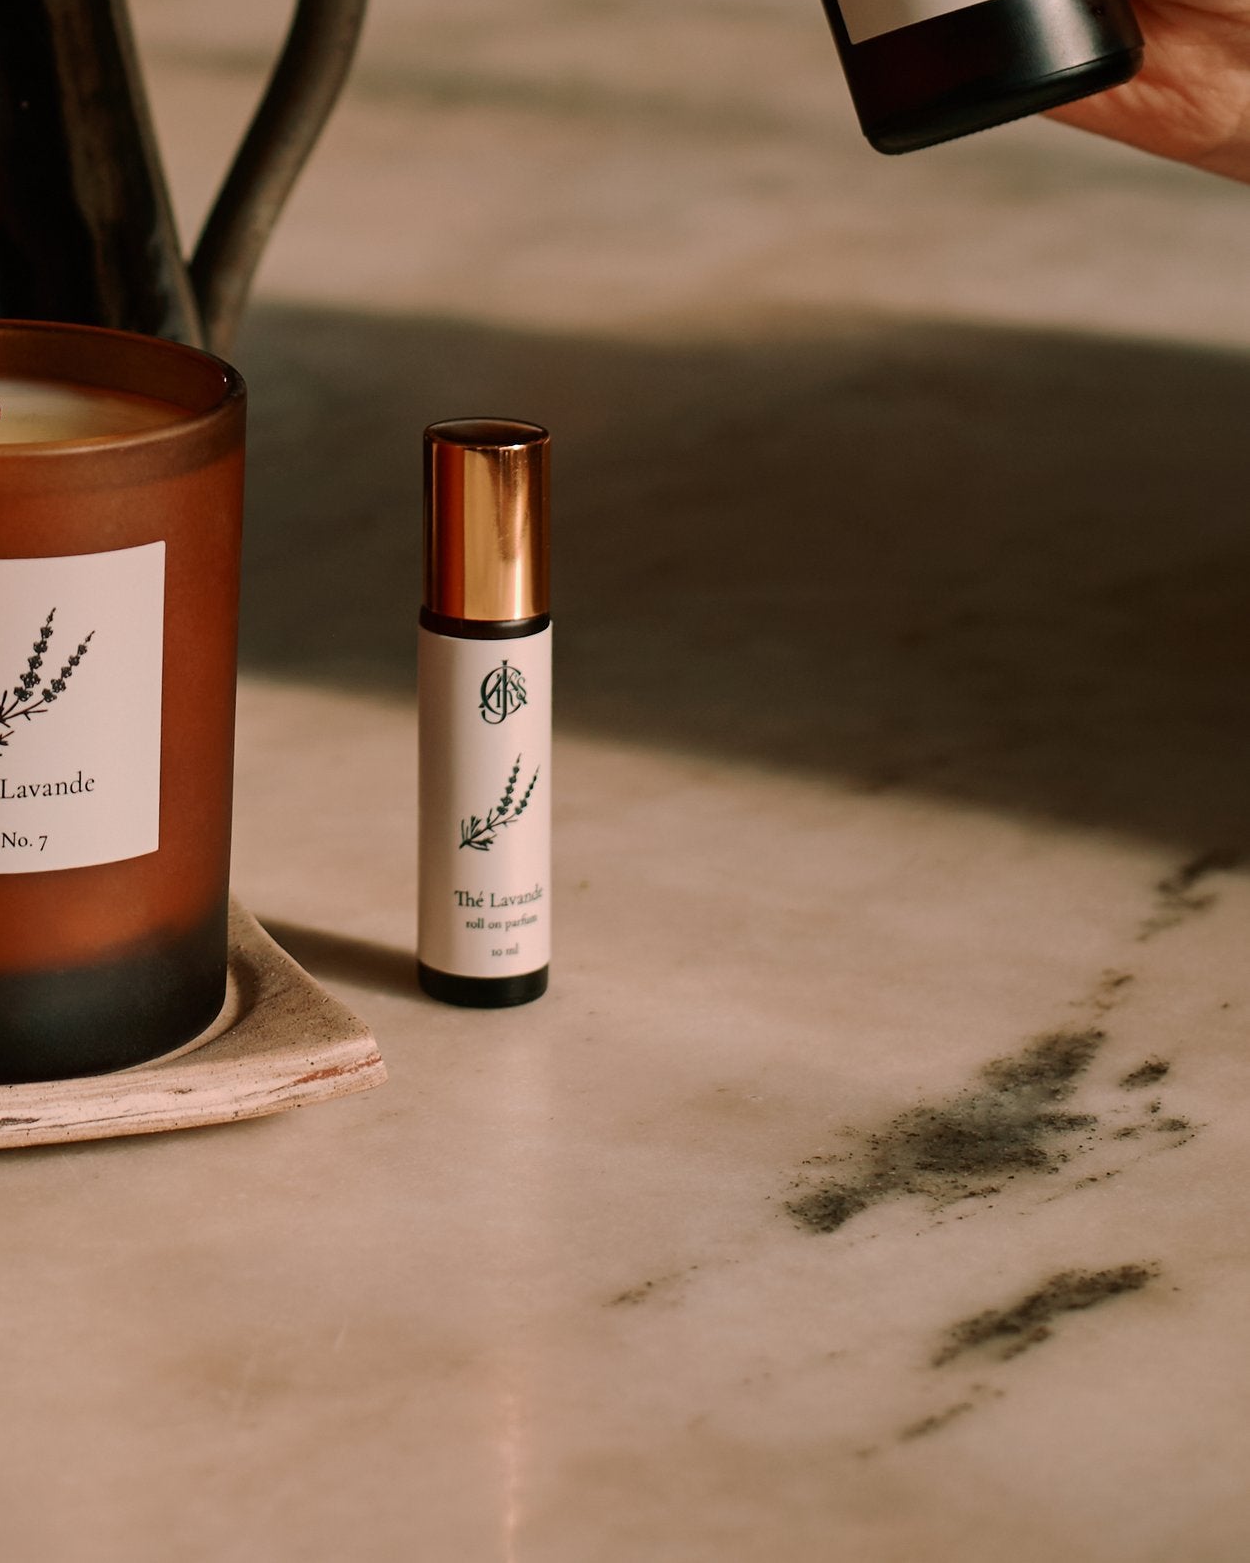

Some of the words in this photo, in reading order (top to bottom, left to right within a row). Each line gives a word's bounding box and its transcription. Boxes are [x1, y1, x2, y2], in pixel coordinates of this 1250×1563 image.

[0, 770, 95, 799] Lavande
[1, 832, 33, 848] No.
[38, 835, 48, 851] 7
[454, 889, 484, 908] Thé
[490, 883, 543, 908] Lavande
[465, 917, 485, 930] roll
[487, 921, 502, 930] on
[505, 912, 538, 932] parfum
[492, 948, 503, 957] 10
[505, 942, 519, 956] ml
